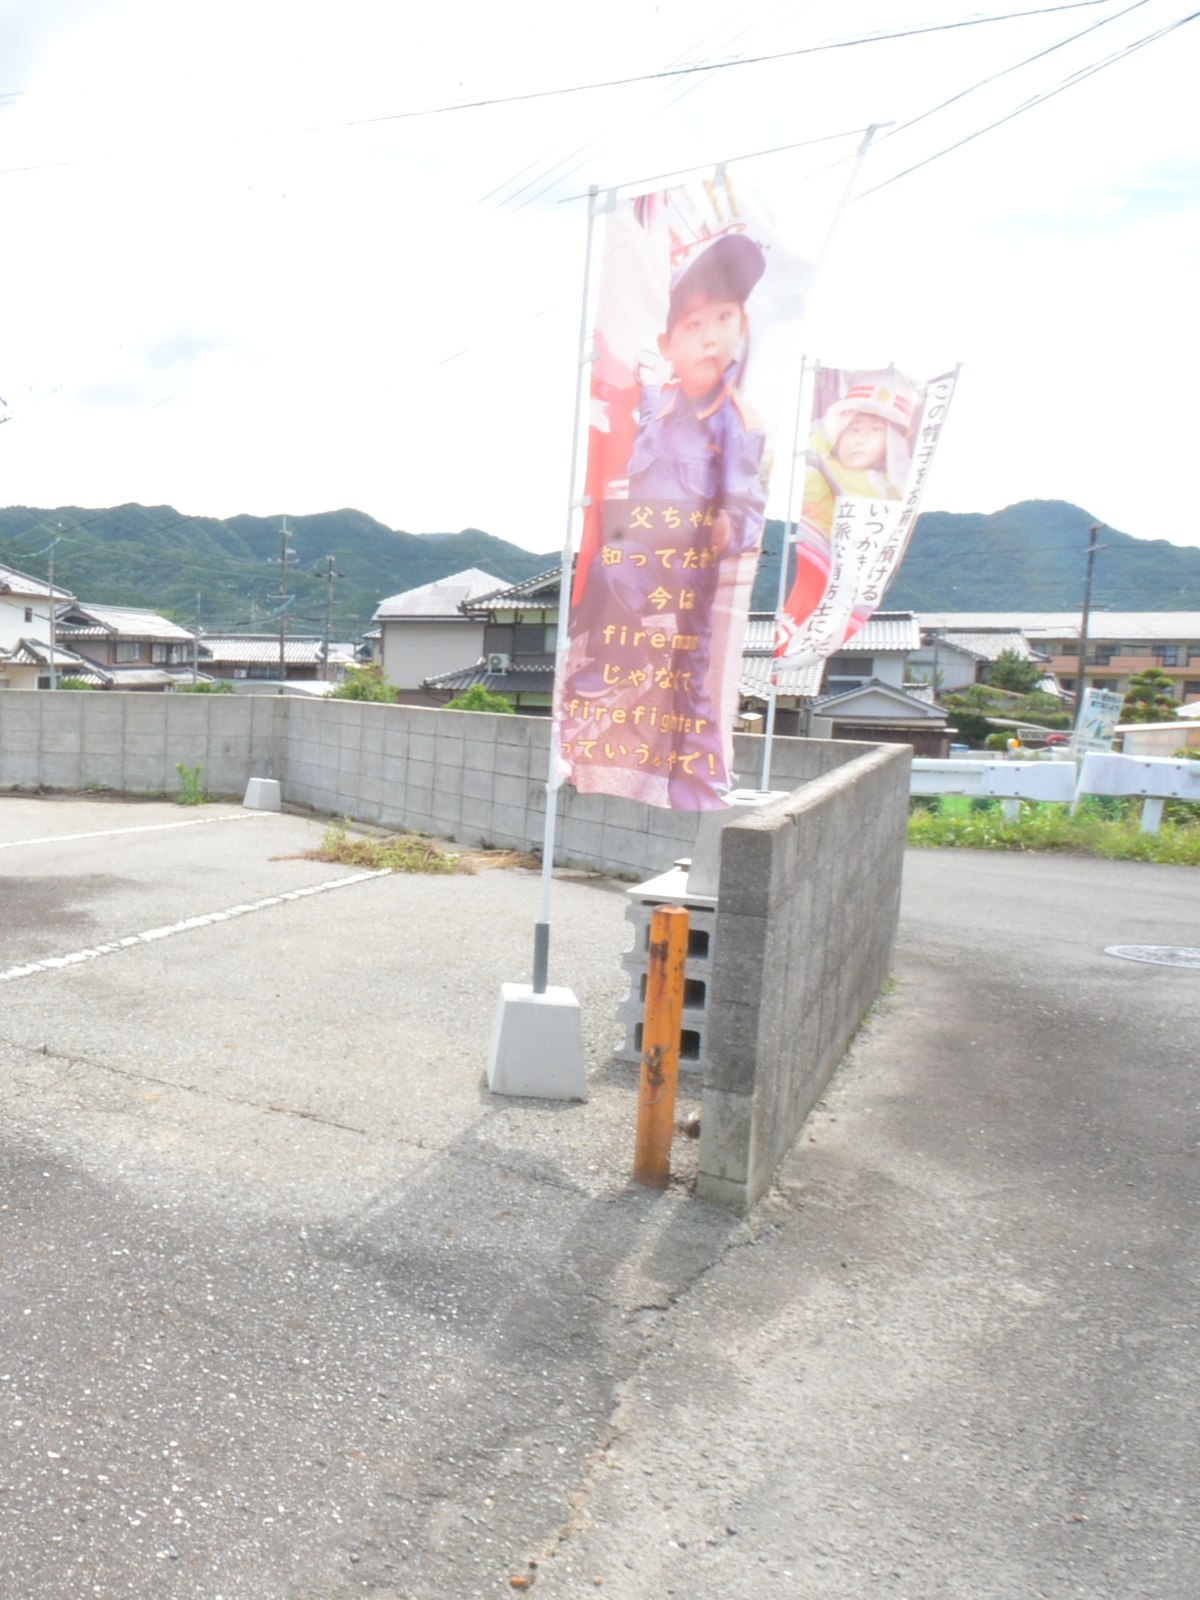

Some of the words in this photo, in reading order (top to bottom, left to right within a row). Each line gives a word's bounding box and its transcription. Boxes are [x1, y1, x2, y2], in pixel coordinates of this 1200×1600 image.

[629, 505, 714, 529] 父ちゃん
[647, 585, 696, 611] 今は
[568, 699, 707, 735] firefighter
